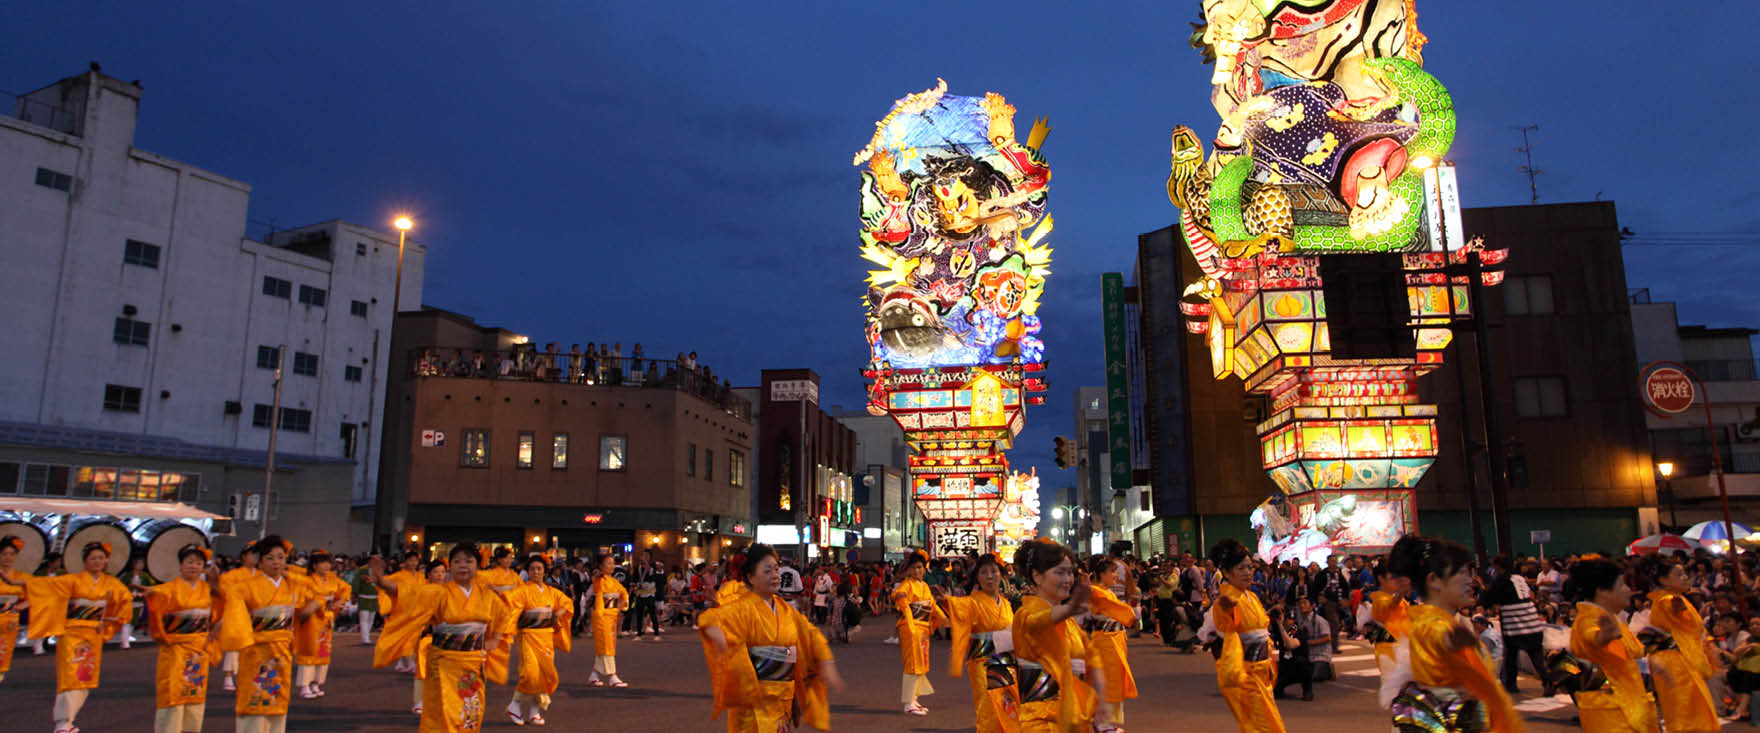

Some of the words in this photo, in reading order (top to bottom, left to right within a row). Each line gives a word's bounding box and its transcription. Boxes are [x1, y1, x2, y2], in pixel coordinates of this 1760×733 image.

[1651, 380, 1691, 399] 消火栓
[434, 431, 445, 446] P
